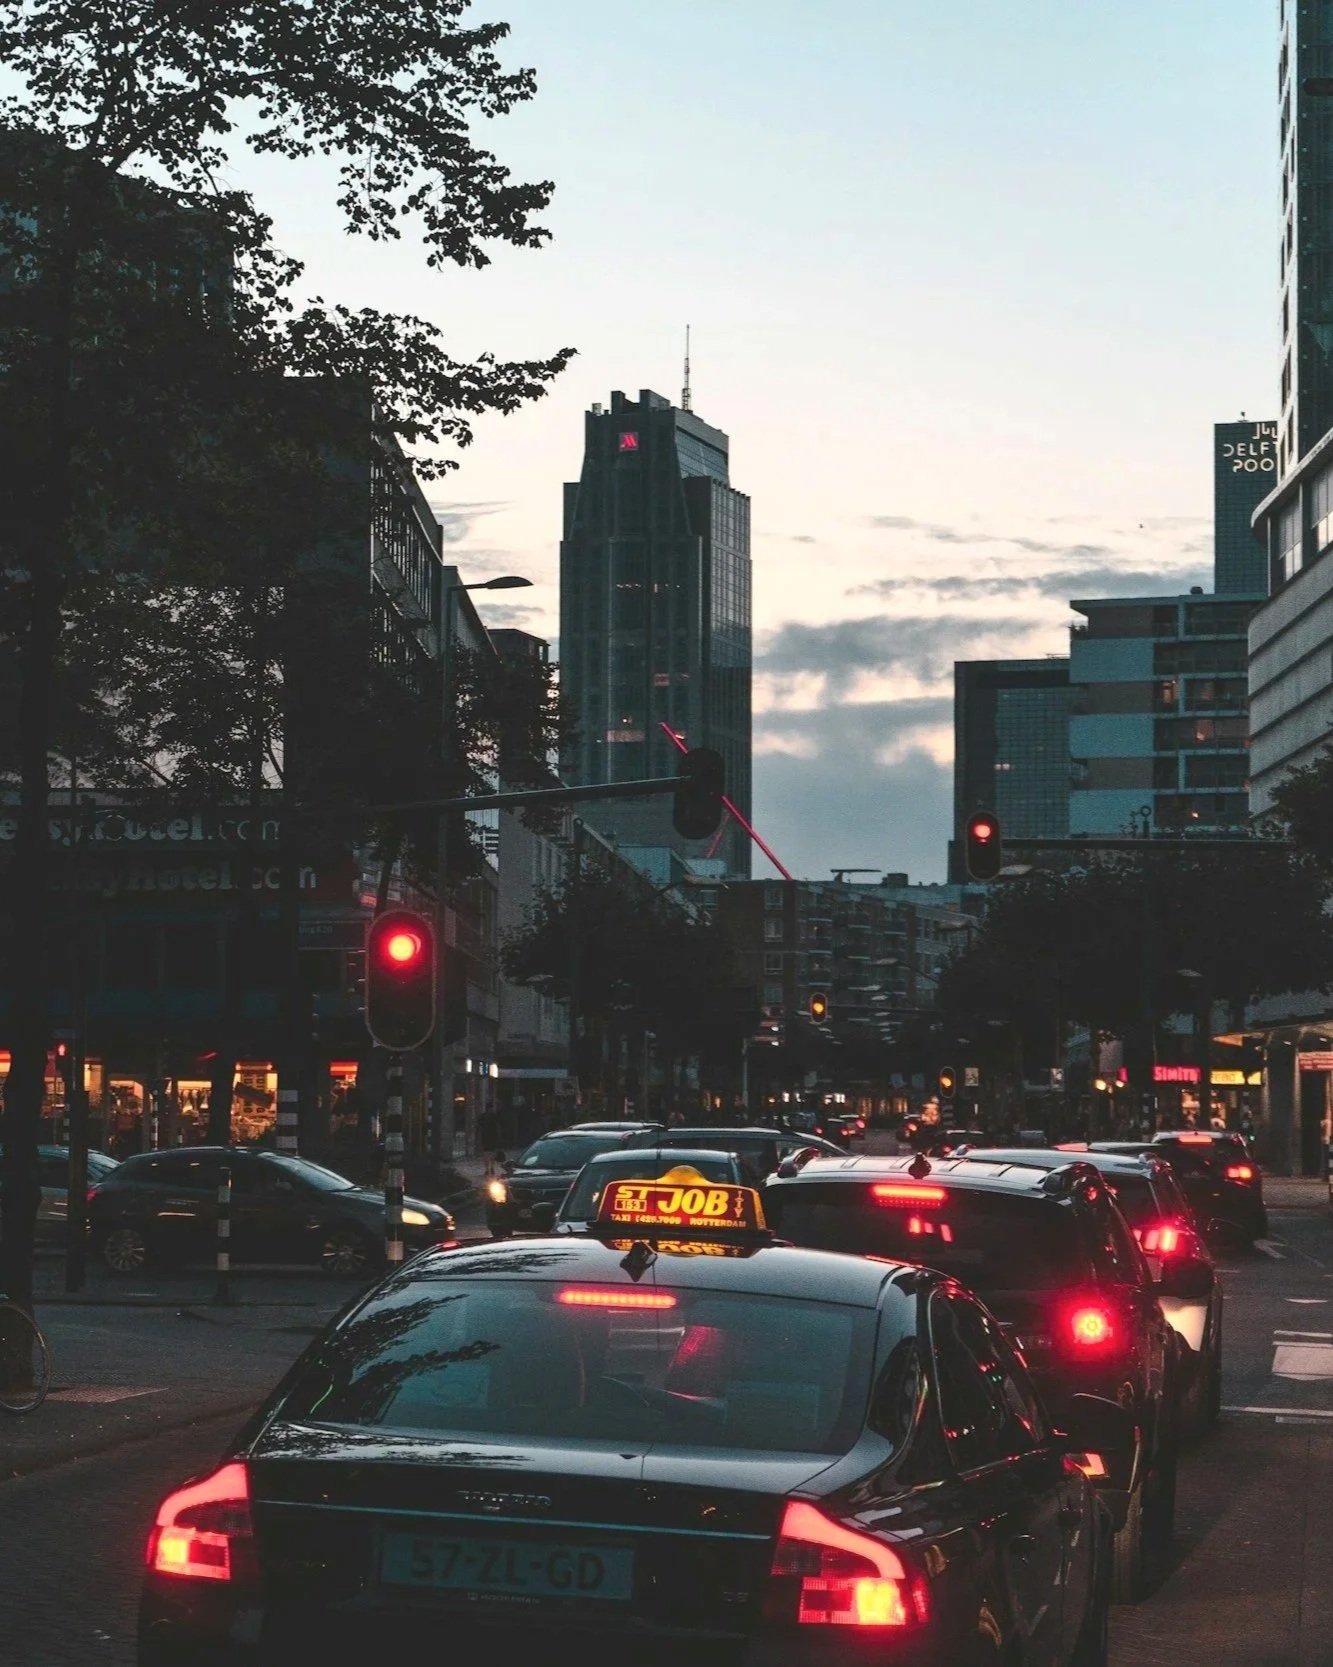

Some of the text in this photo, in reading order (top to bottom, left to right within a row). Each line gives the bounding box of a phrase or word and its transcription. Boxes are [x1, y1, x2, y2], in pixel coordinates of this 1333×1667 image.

[1232, 458, 1275, 473] POO
[615, 1186, 649, 1200] ST
[657, 1188, 730, 1216] JOB
[610, 1213, 632, 1223] TAXI
[689, 1217, 747, 1228] ROTTERDAM
[410, 1538, 604, 1591] 57-ZL-GD
